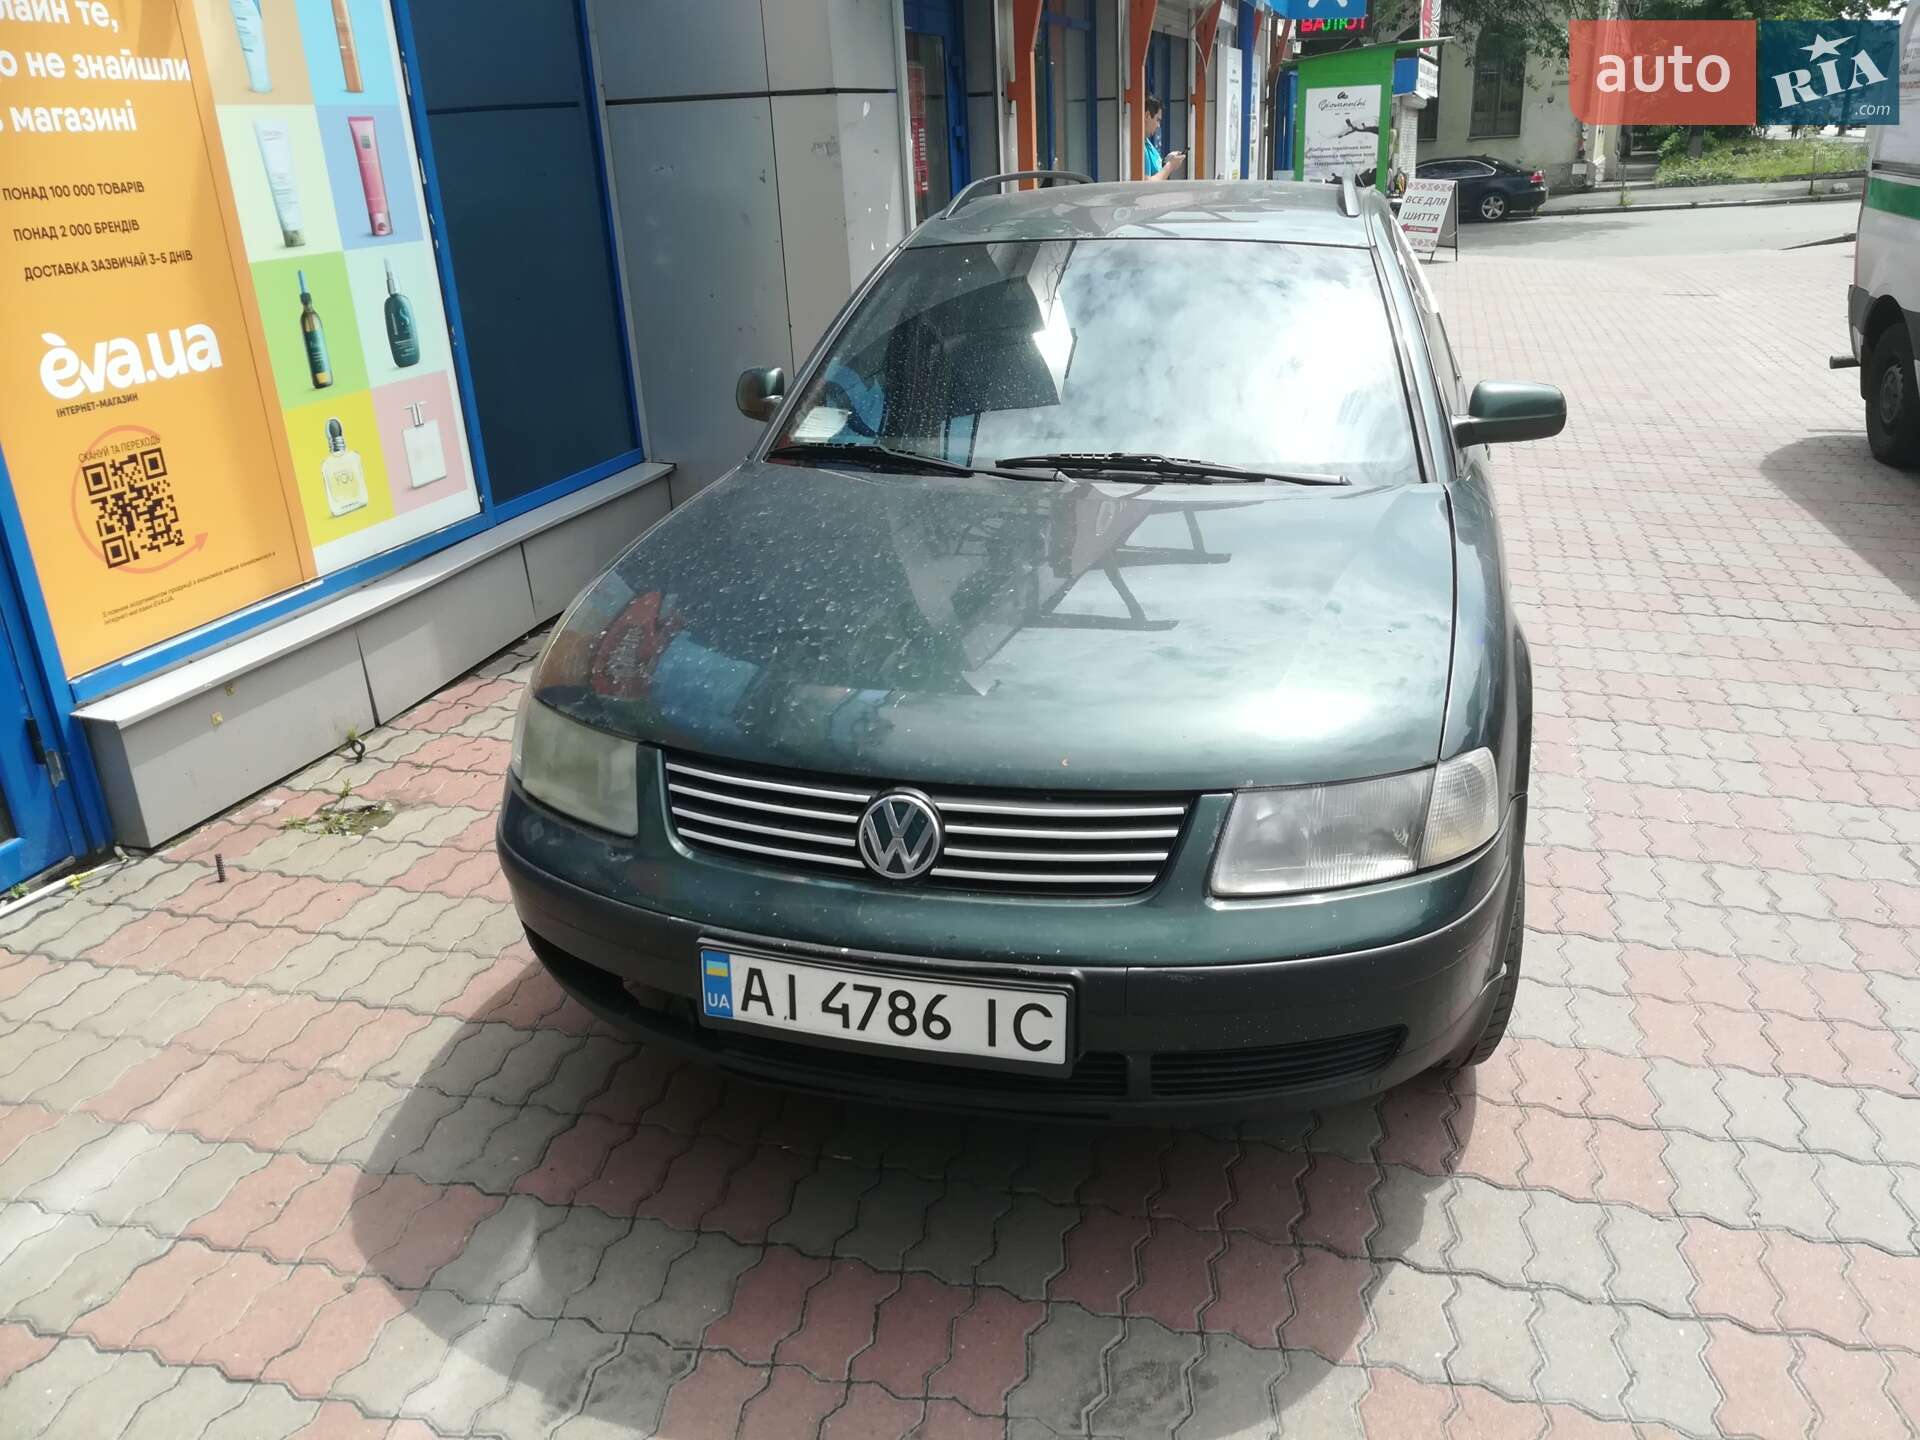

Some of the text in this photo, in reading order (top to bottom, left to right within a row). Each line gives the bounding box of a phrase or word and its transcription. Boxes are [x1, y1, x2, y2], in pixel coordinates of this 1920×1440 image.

[75, 0, 119, 33] те,
[25, 51, 66, 79] не
[72, 48, 192, 81] знайшли
[9, 99, 138, 133] магазині
[2, 181, 145, 201] ПОНАД 100 000 ТОВАРІВ
[1405, 195, 1448, 207] ВСЕ ДЛЯ
[1403, 211, 1440, 222] ШИТТЯ
[13, 219, 140, 242] ПОНАД 2 000 БРЕНДІВ
[24, 249, 193, 282] ДОСТАВКА ЗАЗВИЧАЙ 3-5 ДНІВ
[56, 393, 139, 418] ІНТЕРНЕТ-МАГАЗИН
[78, 434, 161, 464] СКАНУЙ ТА ПЕРЕХОДЬ
[707, 992, 730, 1009] UA
[741, 967, 1053, 1051] AI 4786 IC
